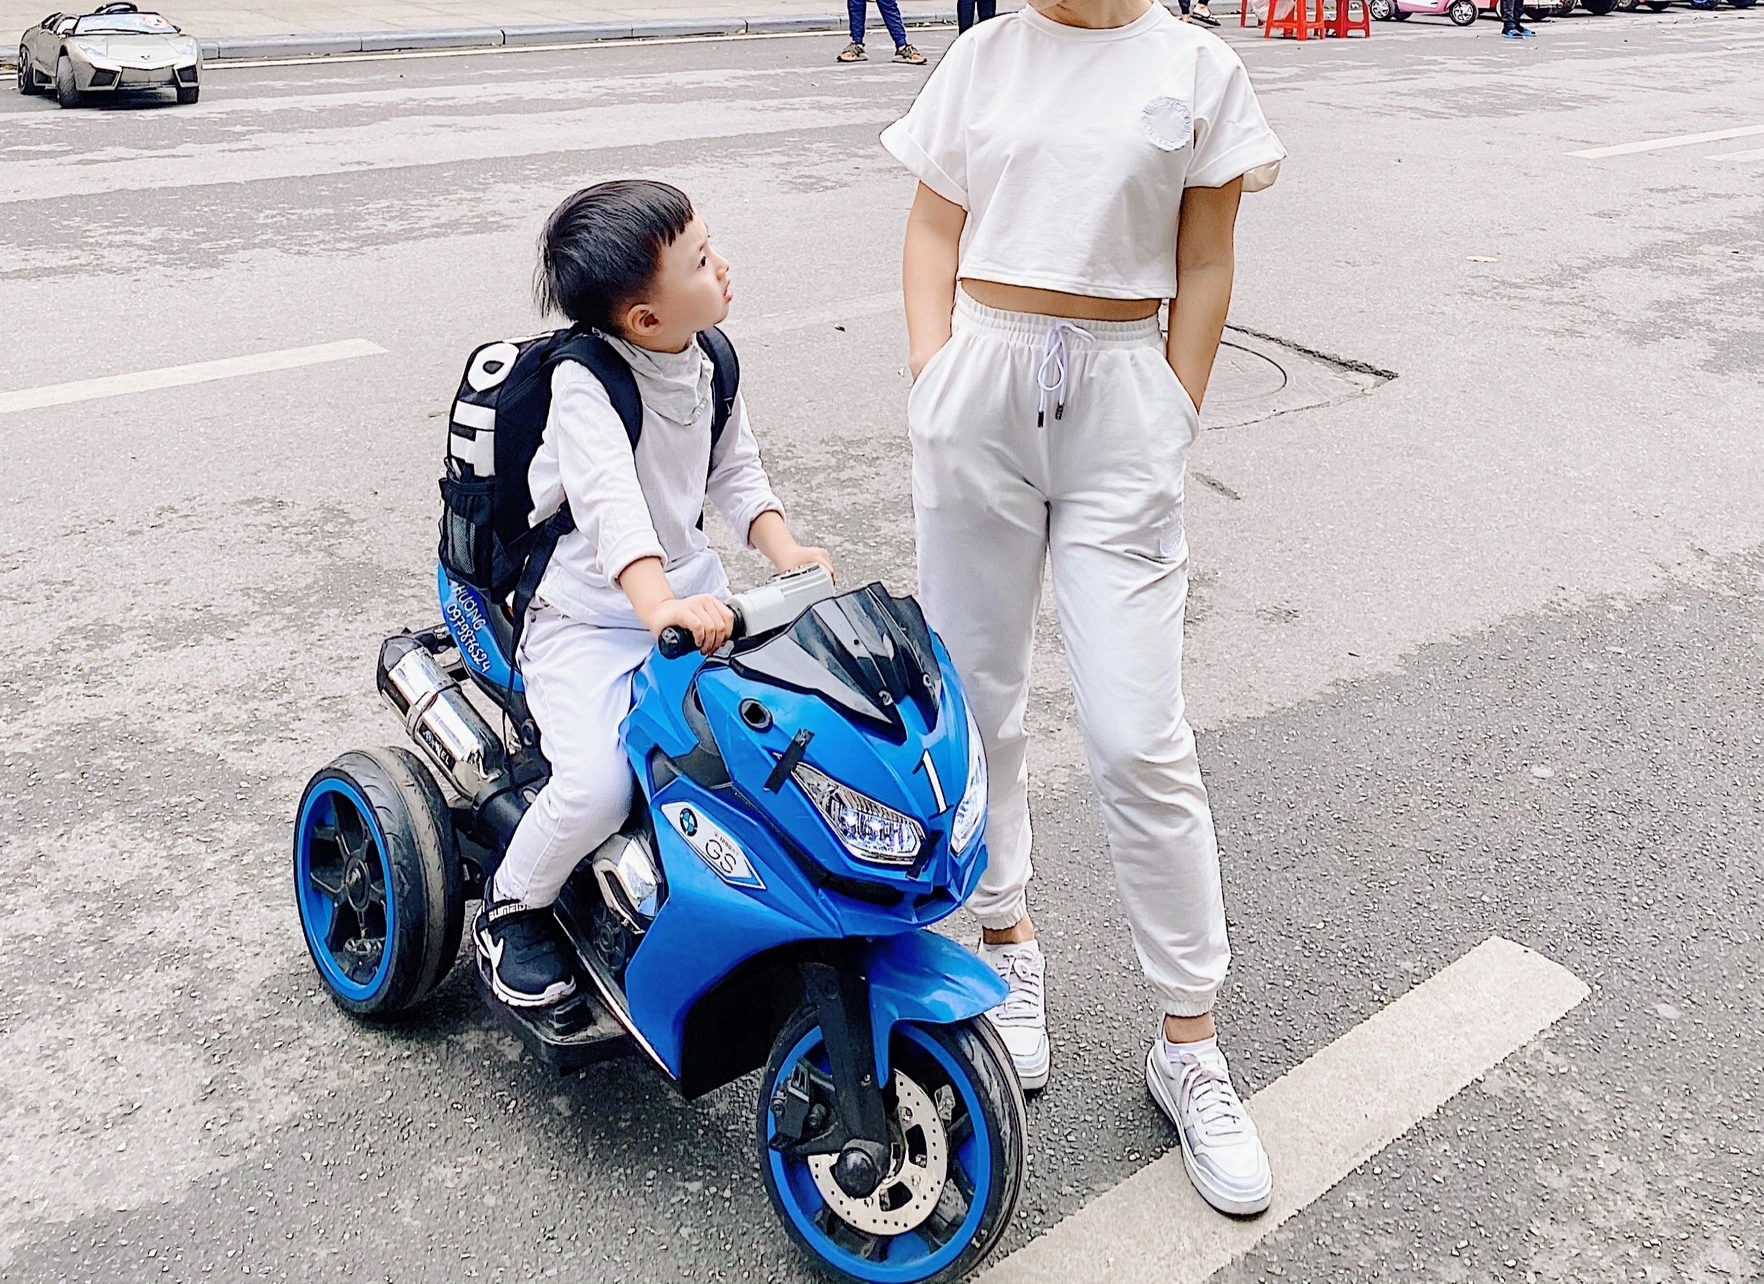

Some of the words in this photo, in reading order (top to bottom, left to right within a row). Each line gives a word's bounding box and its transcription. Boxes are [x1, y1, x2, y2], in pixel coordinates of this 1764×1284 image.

[447, 603, 491, 673] 0979876524
[912, 748, 954, 820] 1
[705, 839, 737, 874] GS
